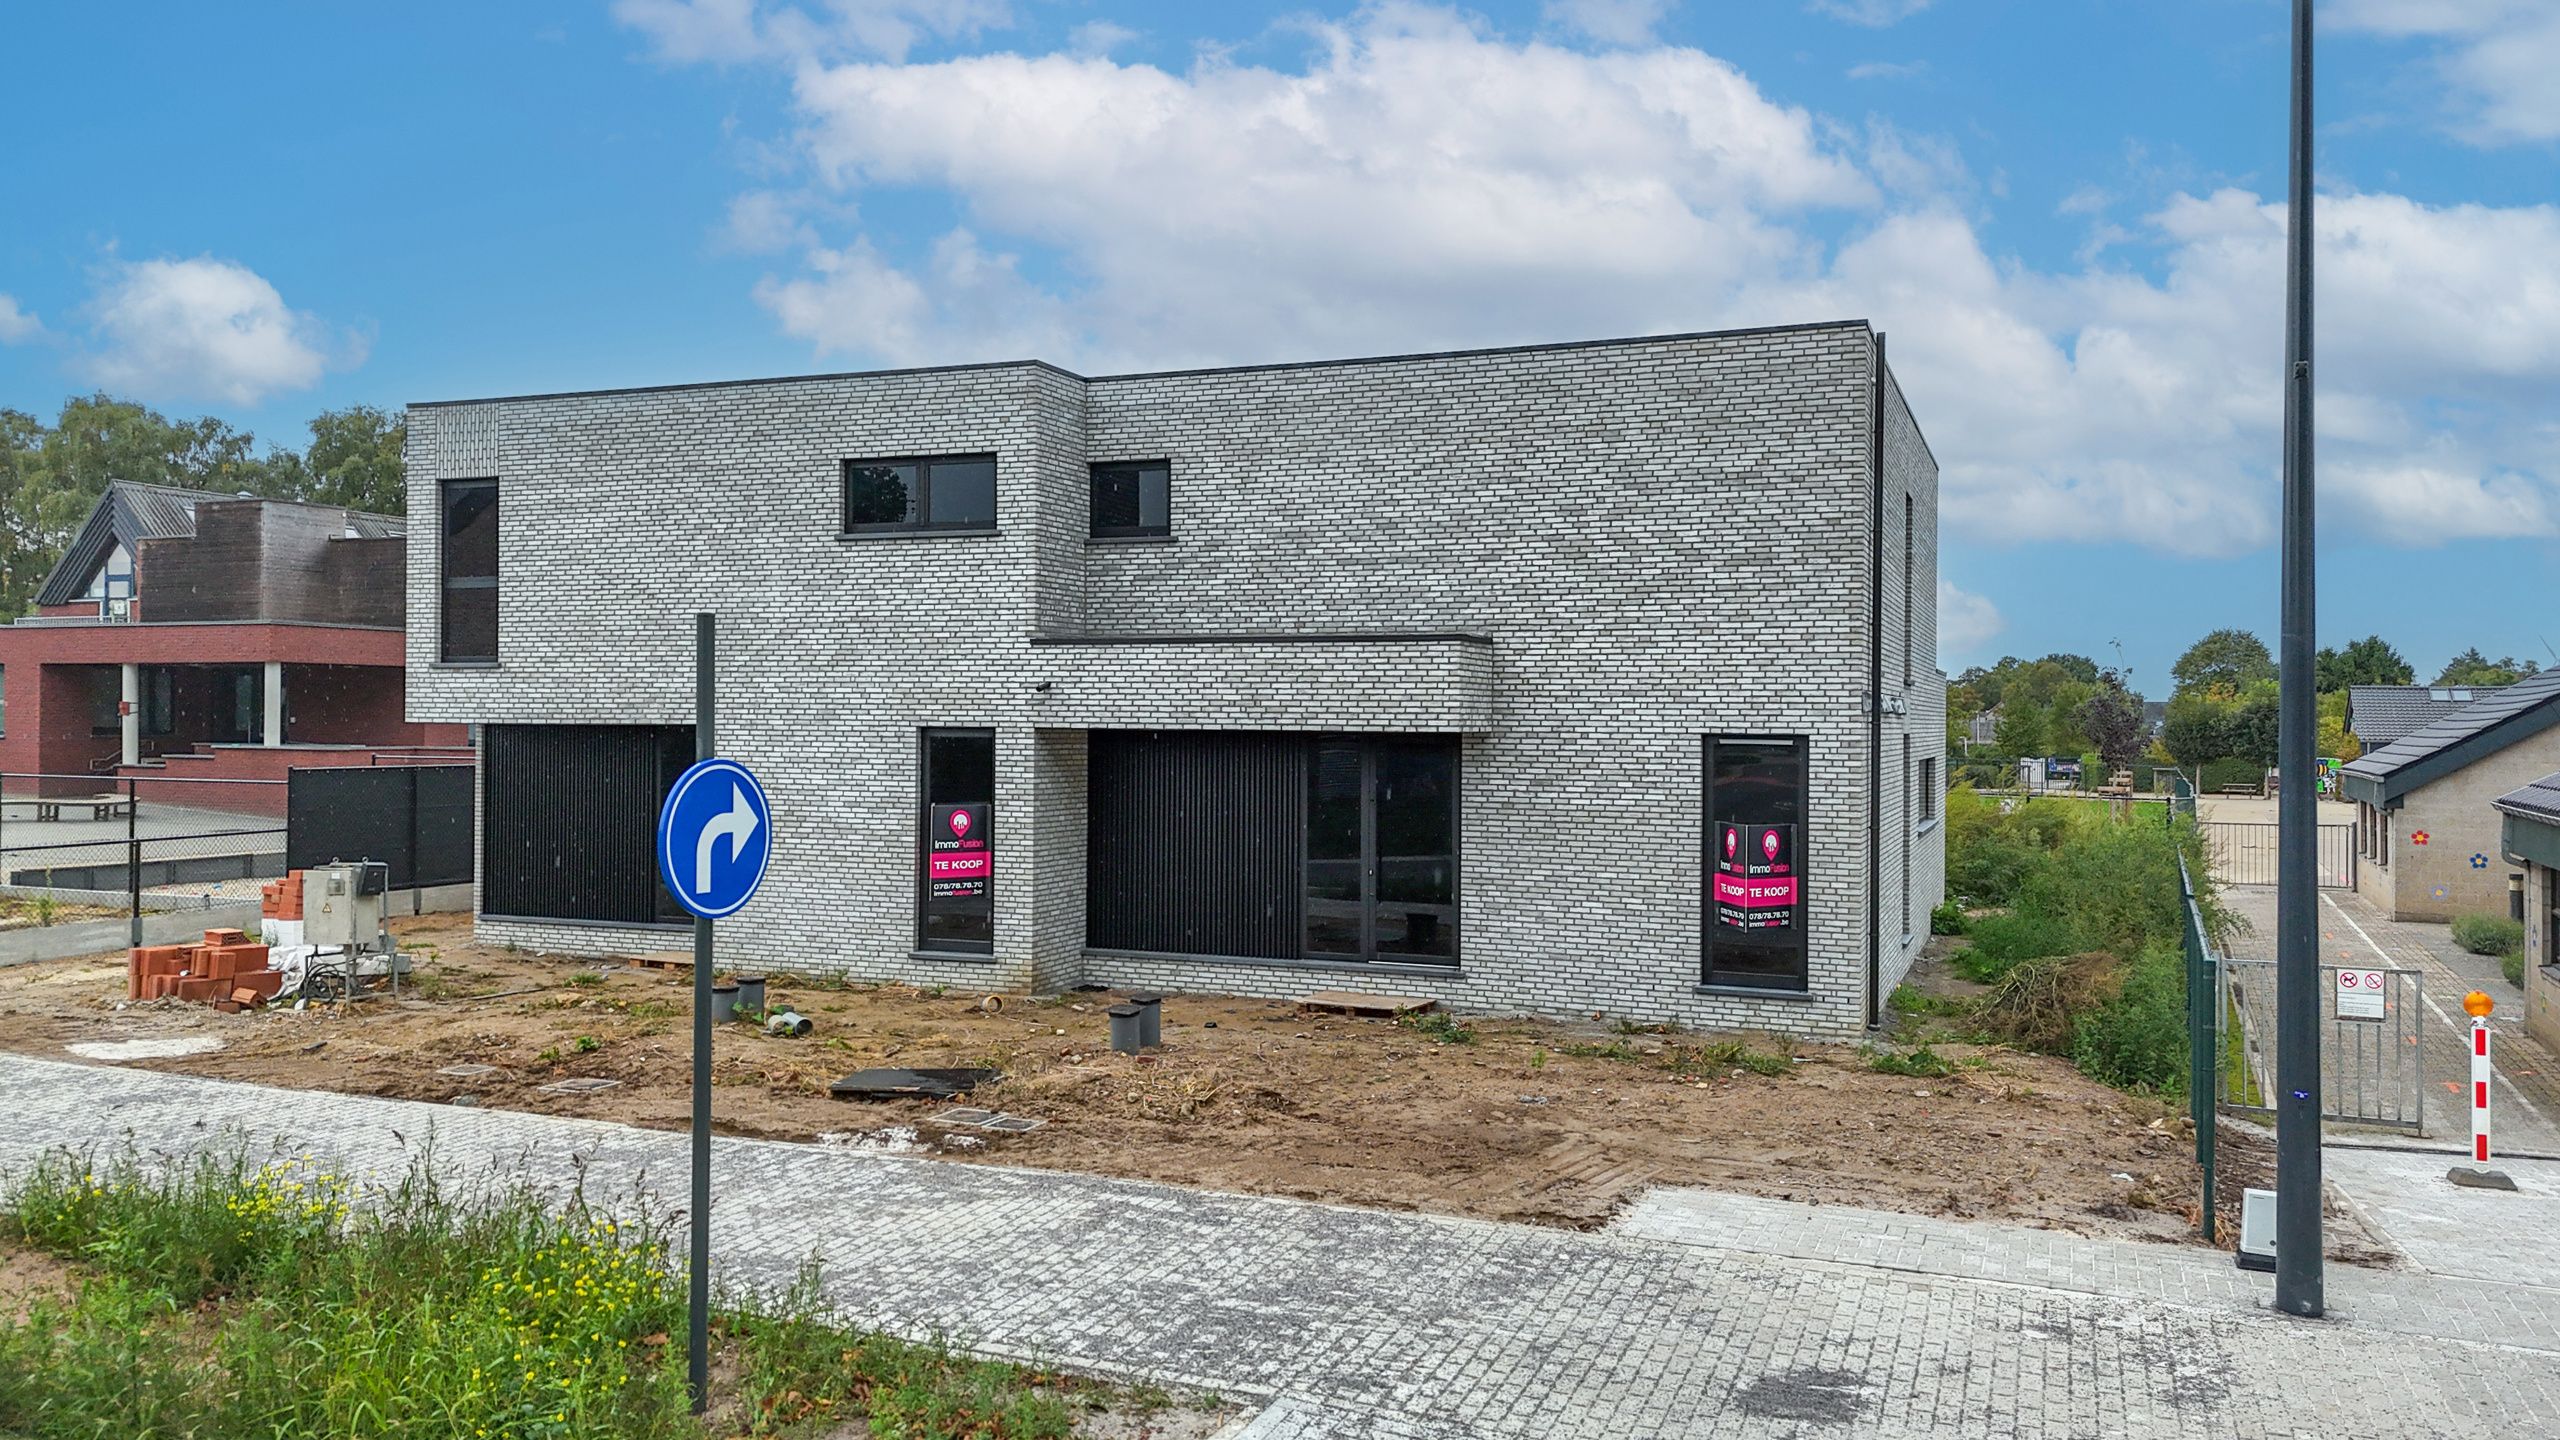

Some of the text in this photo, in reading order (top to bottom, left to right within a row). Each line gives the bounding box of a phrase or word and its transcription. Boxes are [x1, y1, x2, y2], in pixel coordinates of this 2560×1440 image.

[934, 860, 984, 870] TE KOOP
[933, 881, 983, 890] 078/78.78.70
[1720, 883, 1745, 896] TE KOOP
[1749, 886, 1789, 898] TE KOOP
[1749, 911, 1789, 920] 078/78.78.70
